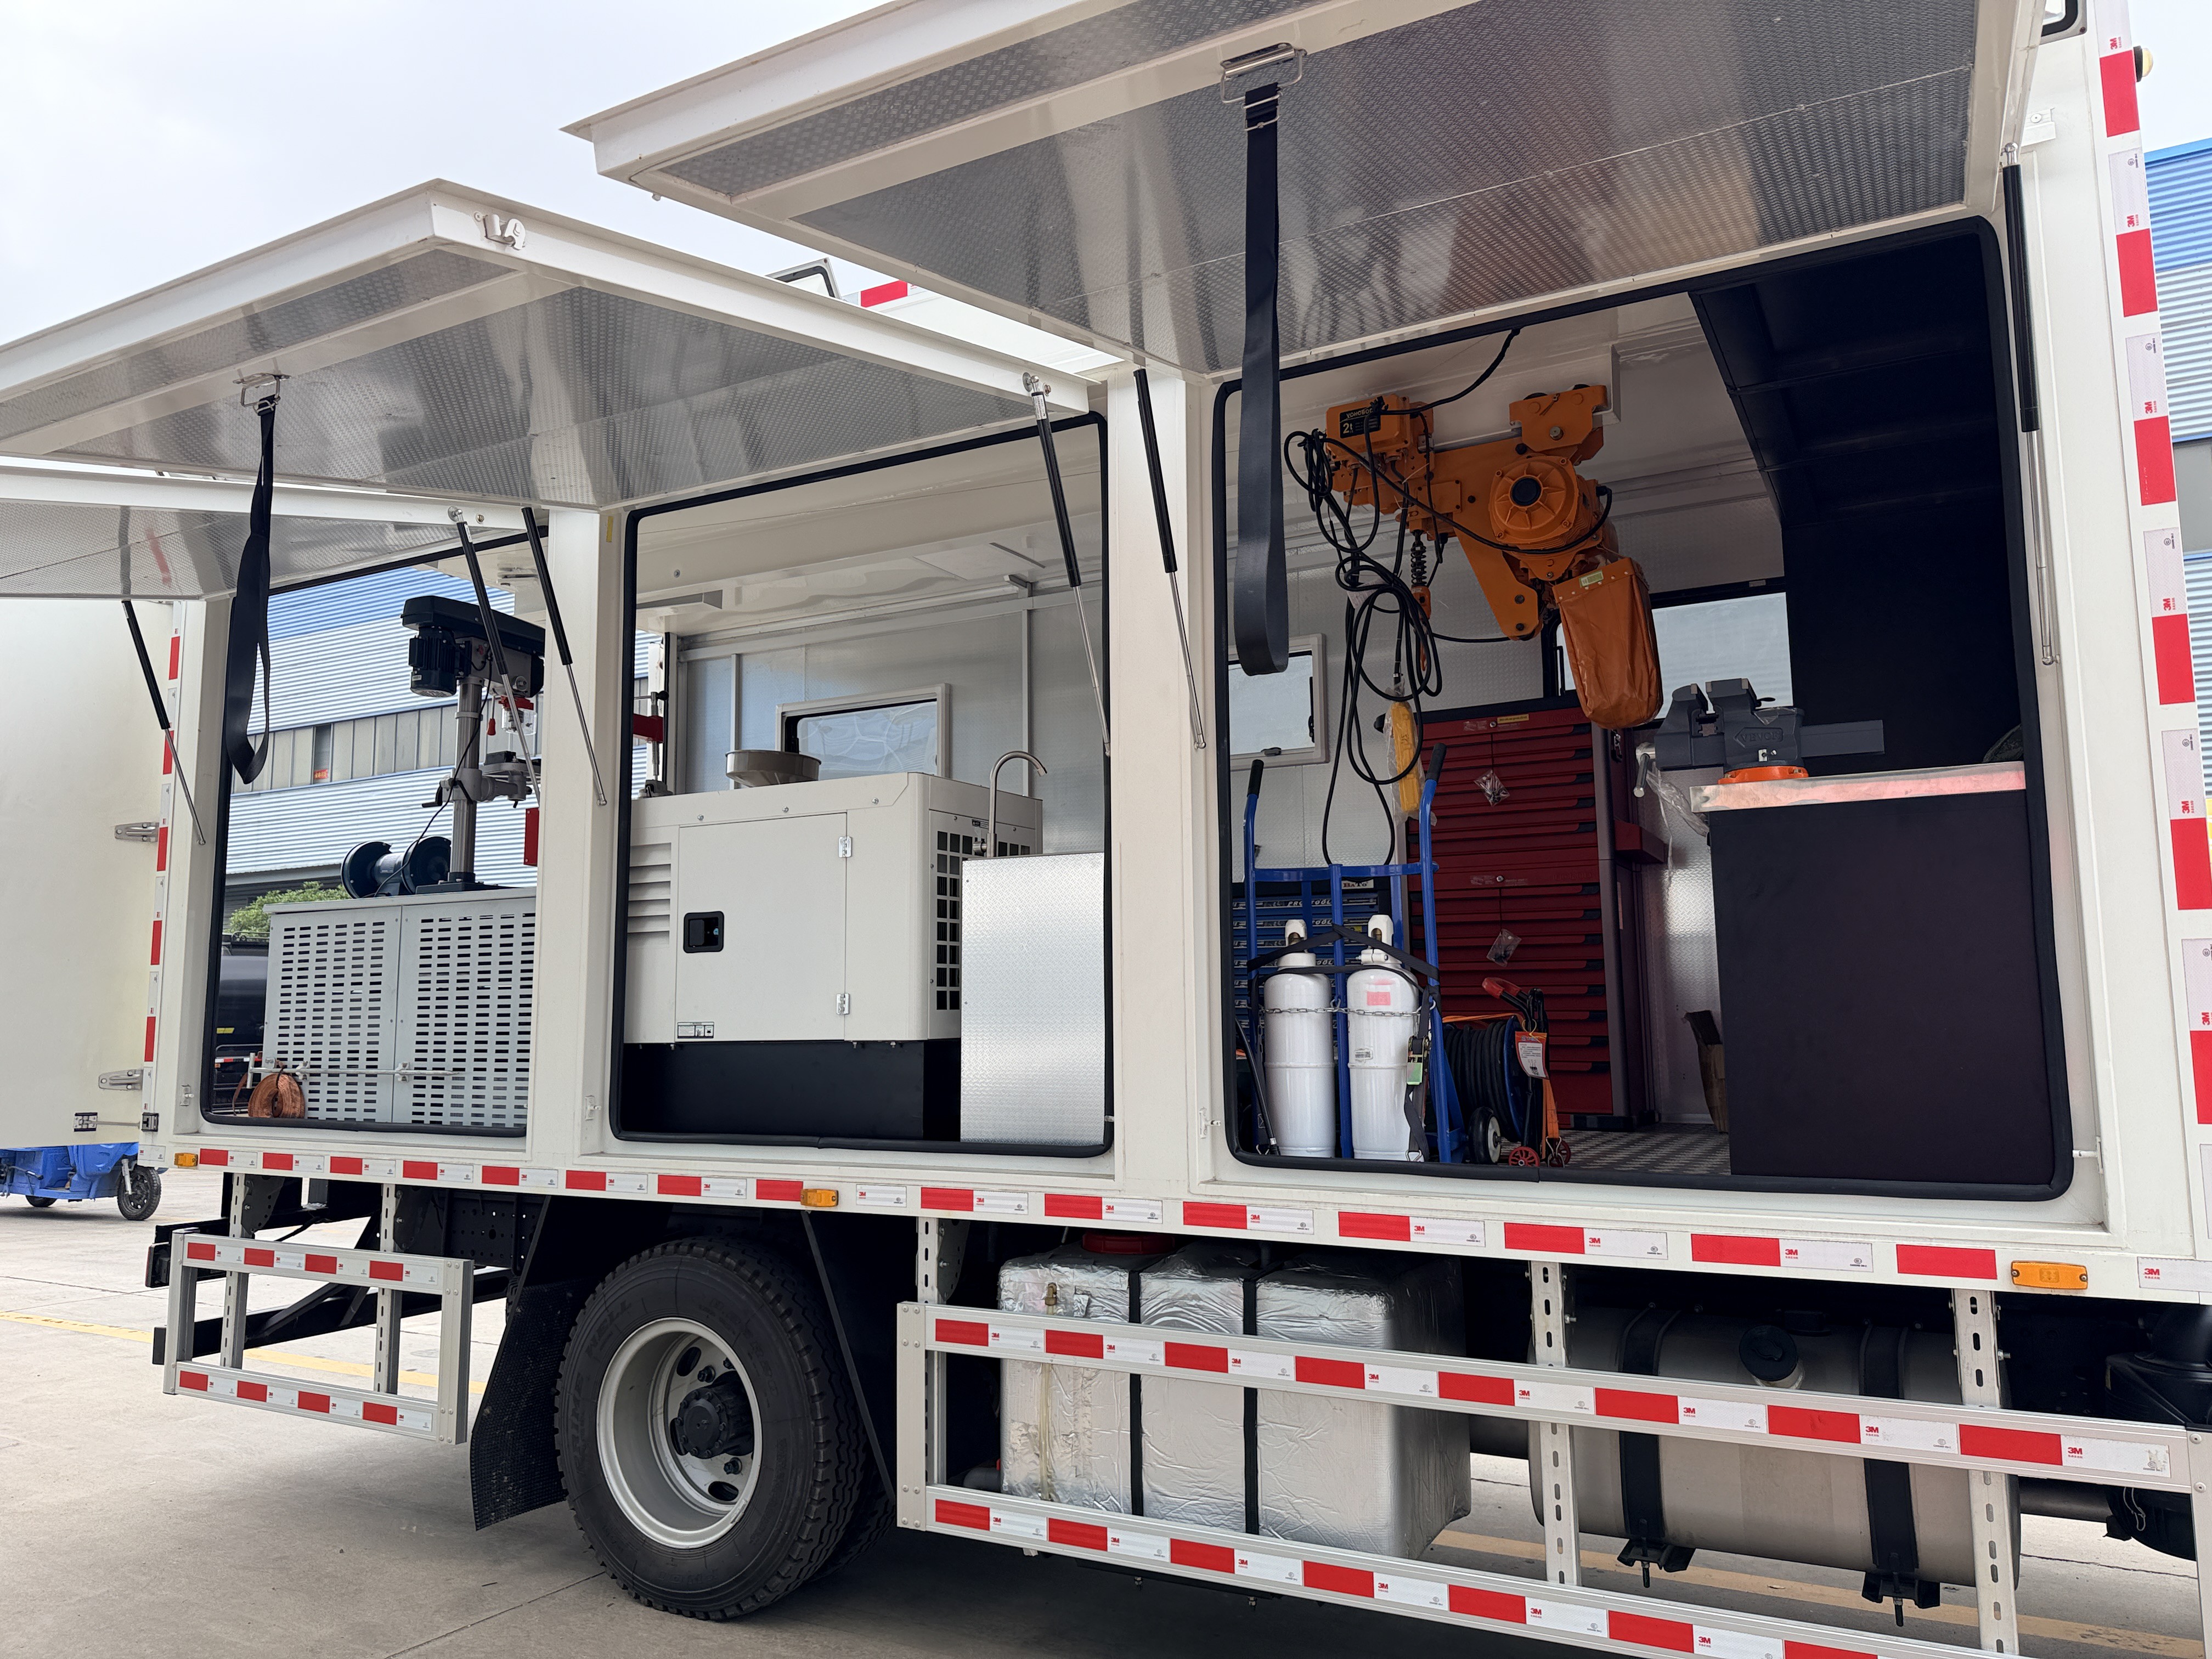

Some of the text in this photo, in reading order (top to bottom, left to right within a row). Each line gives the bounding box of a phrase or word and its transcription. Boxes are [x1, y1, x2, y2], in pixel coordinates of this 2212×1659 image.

[2127, 215, 2135, 227] 3M
[2145, 401, 2153, 414] 3M
[2163, 597, 2171, 611] 3M
[2181, 800, 2190, 814] 3M
[2201, 1012, 2210, 1025] 3M
[2067, 1447, 2083, 1455] 3M
